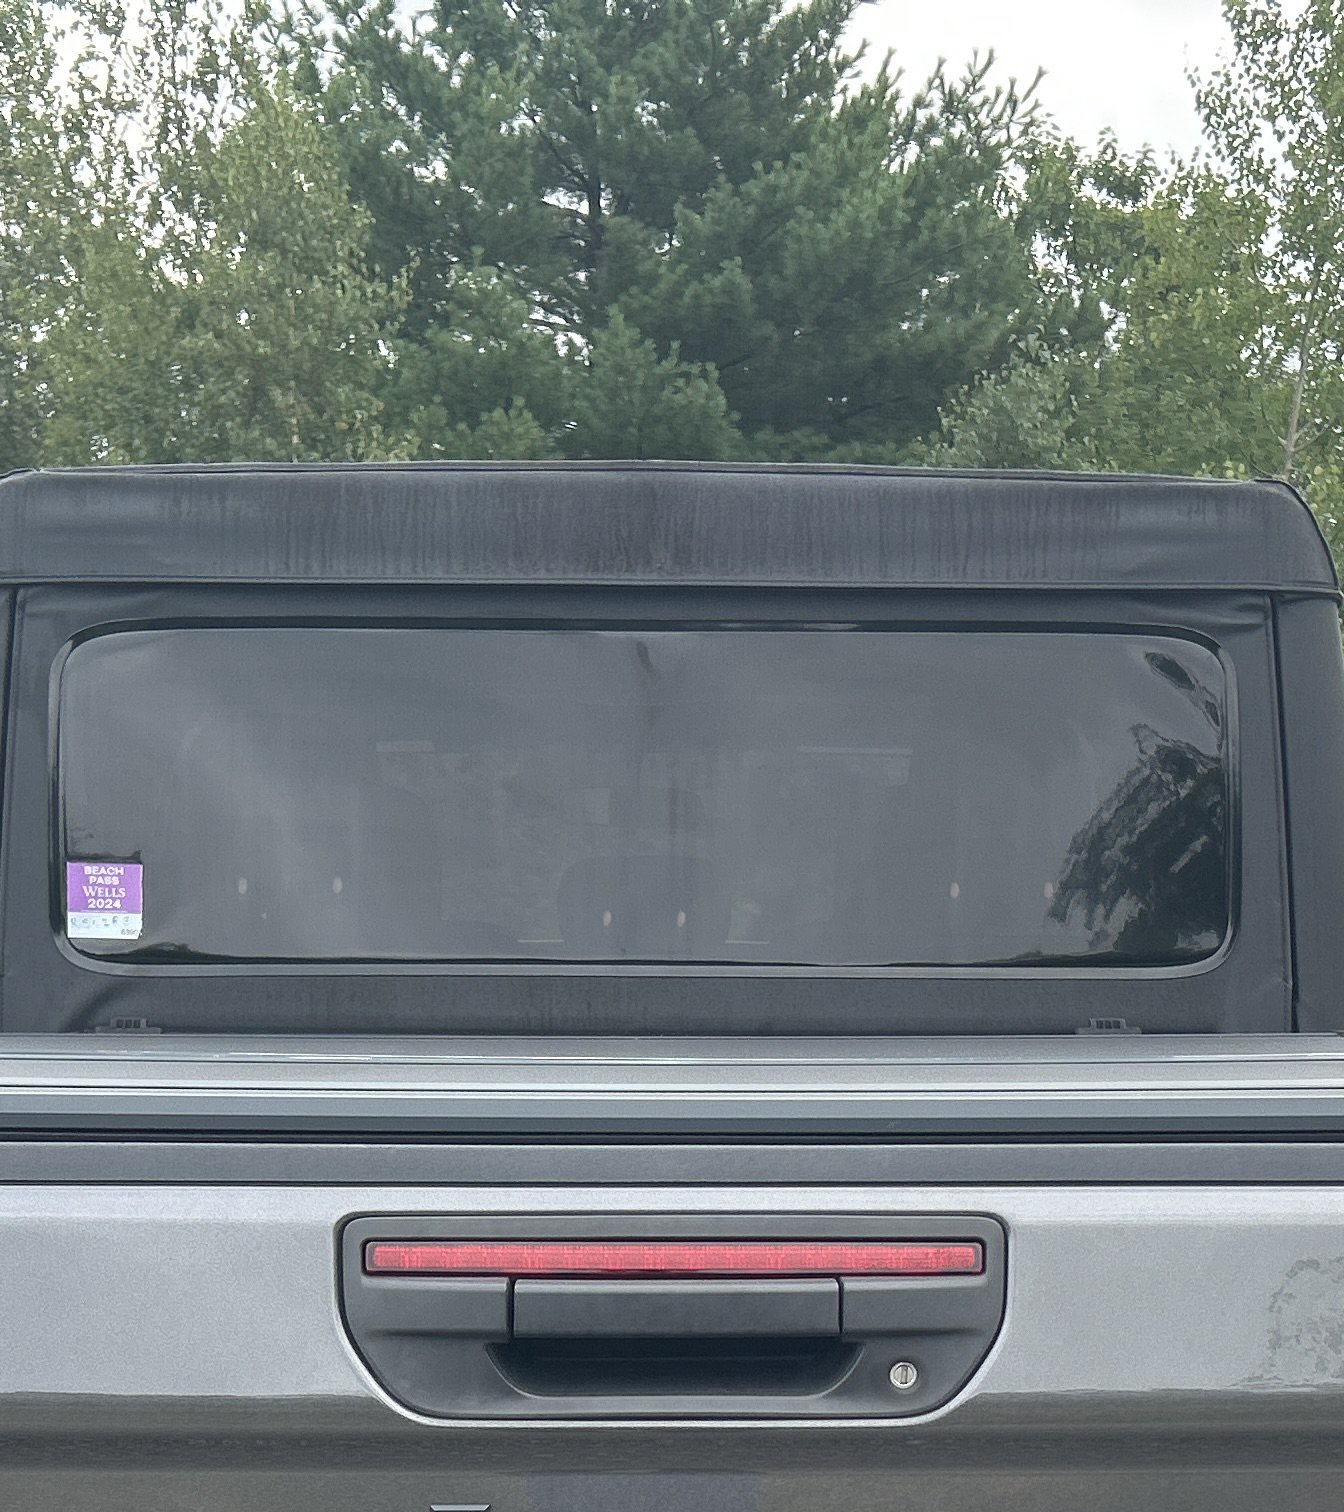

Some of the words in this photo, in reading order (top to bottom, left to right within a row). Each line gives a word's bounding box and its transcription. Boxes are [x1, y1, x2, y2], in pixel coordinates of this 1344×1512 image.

[83, 865, 125, 876] BEACH
[89, 875, 120, 885] PASS
[82, 885, 126, 898] WELLS
[87, 898, 122, 909] 2024
